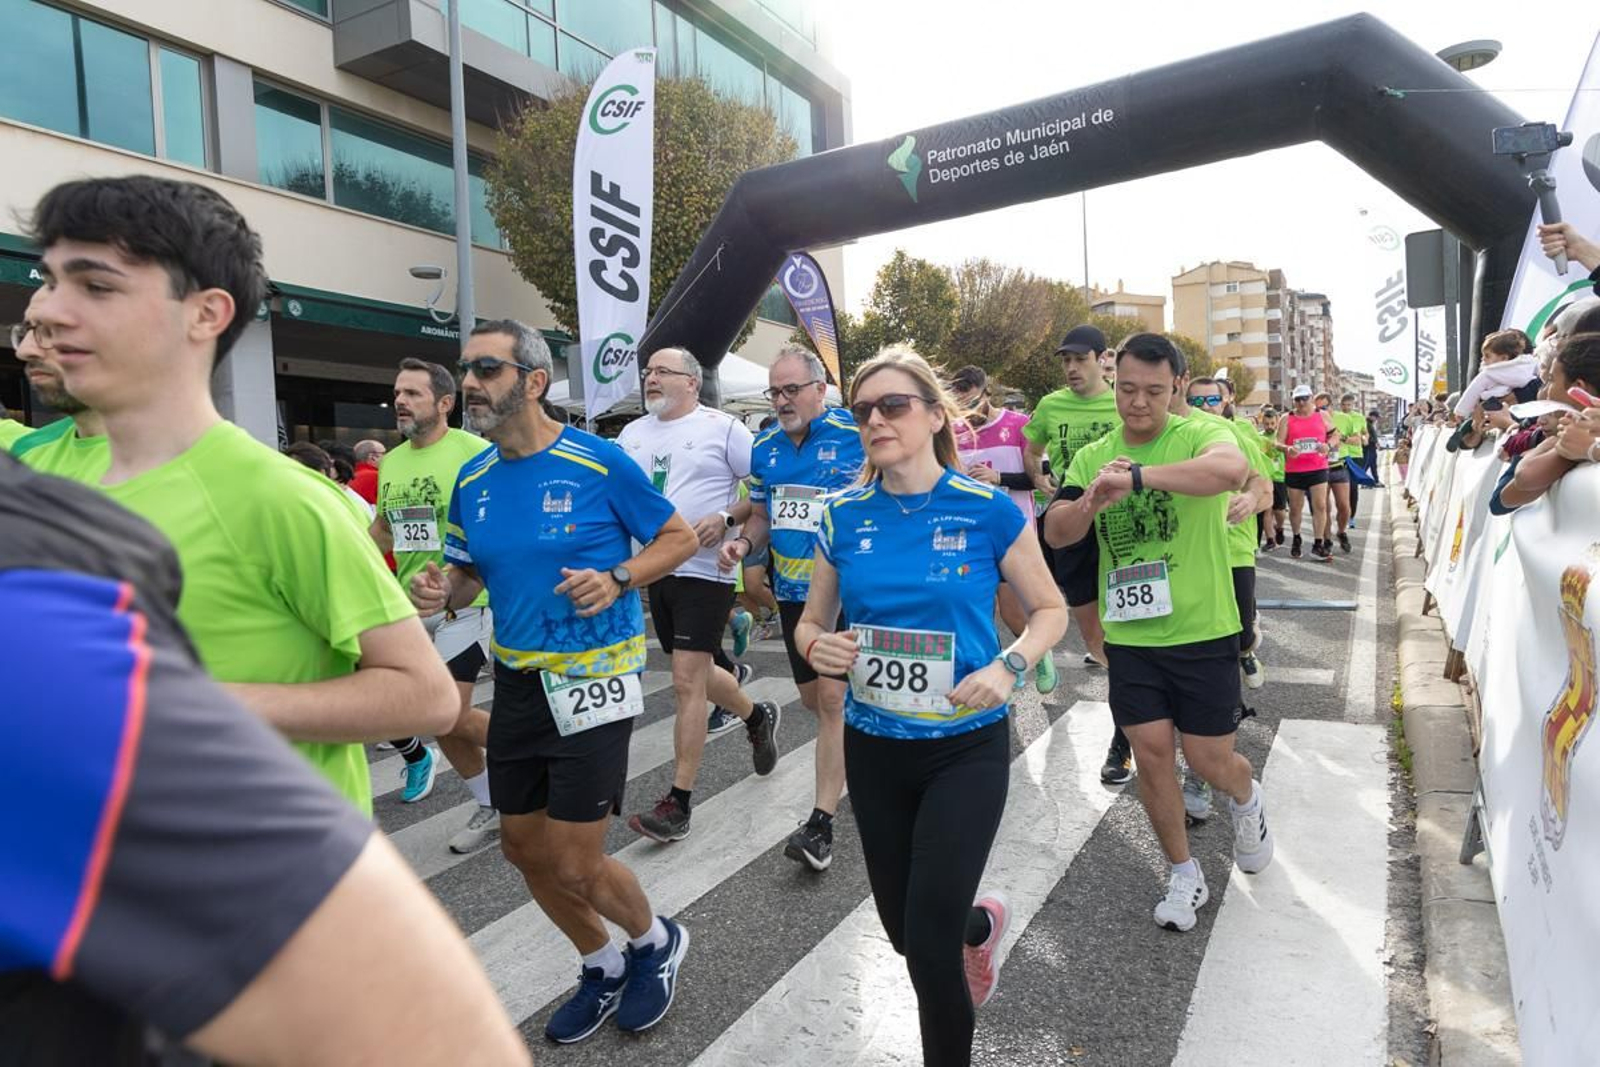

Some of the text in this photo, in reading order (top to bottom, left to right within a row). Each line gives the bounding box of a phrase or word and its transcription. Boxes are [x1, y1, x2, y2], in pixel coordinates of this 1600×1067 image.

[600, 99, 645, 118] CSIF
[927, 107, 1115, 165] Patronato Municipal de
[929, 138, 1070, 184] Deportes de Jaén
[589, 170, 640, 303] CSIF
[602, 347, 637, 367] CSIF
[778, 501, 810, 520] 233
[403, 523, 429, 541] 325
[1116, 584, 1154, 609] 358
[866, 657, 928, 693] 298
[568, 676, 626, 715] 299
